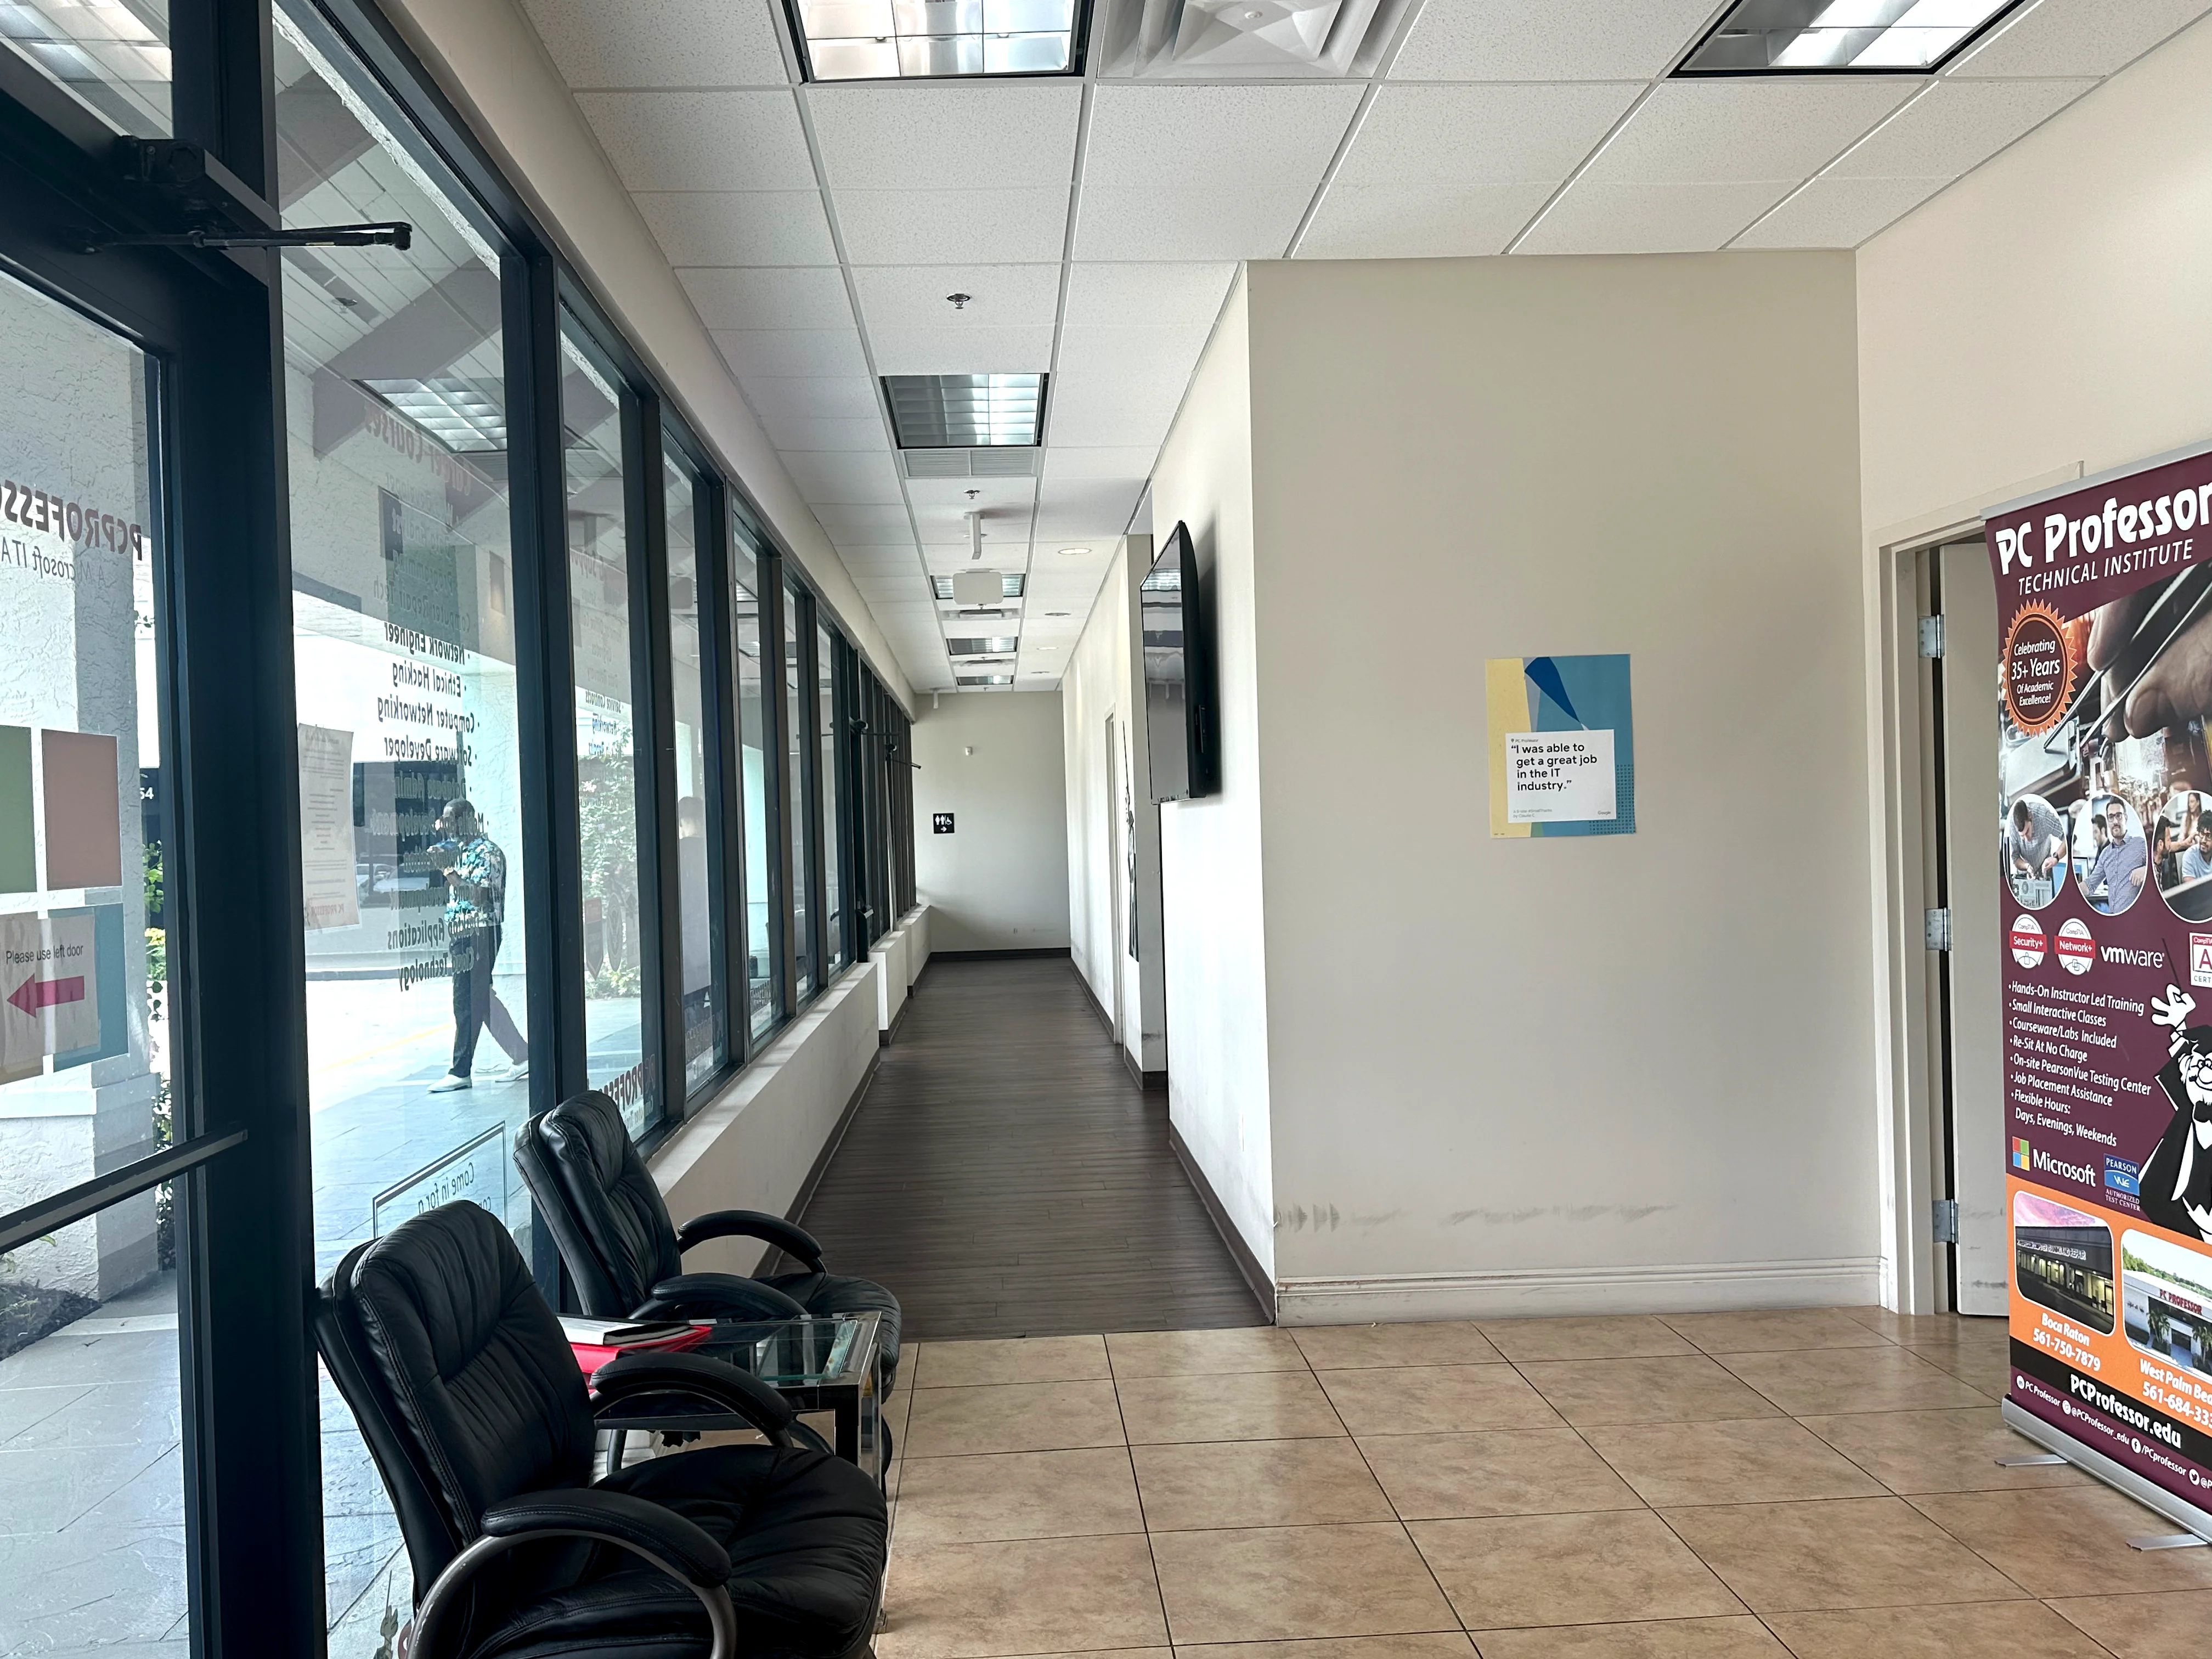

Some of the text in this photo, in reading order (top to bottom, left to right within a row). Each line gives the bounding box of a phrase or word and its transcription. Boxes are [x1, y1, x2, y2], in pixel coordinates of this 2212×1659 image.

[1995, 481, 2212, 575] PC Professor
[2018, 538, 2193, 595] TECHNICAL INSTITUTE
[2014, 639, 2056, 656] Celebrating
[2011, 658, 2060, 680] 35+ Years
[2019, 693, 2051, 706] Excellence!
[2023, 680, 2054, 693] Academic
[1516, 757, 1535, 768] get
[1547, 756, 1577, 768] great
[1579, 754, 1597, 766] job
[1522, 745, 1544, 754] was
[1547, 743, 1570, 753] able
[1573, 743, 1584, 752] to
[1517, 768, 1560, 778] in the IT
[6, 944, 83, 964] Please use left door
[2013, 936, 2044, 948] Security+
[2059, 940, 2092, 954] Network+
[2012, 981, 2144, 1017] Hands-On Instructor Led Training
[2012, 999, 2106, 1027] Small Interactive Classes
[2013, 1017, 2117, 1048] Courseware/Labs Included
[2013, 1035, 2087, 1063] Re-Sit At No Charge
[2013, 1053, 2151, 1096] On-site PearsonVue Testing Center
[2013, 1072, 2112, 1106] Job Placement Assistance
[2015, 1089, 2071, 1114] Flexible Hours:
[2015, 1107, 2117, 1147] Days, Evenings, Weekends
[2033, 1149, 2096, 1187] Microsoft
[2106, 1157, 2137, 1175] PEARSON
[2105, 1194, 2140, 1212] TEST CENTER
[2106, 1188, 2140, 1204] AUTHORIZED
[2041, 1313, 2090, 1346] Boca Raton
[2033, 1328, 2101, 1372] 561-750-7879
[2140, 1358, 2164, 1383] West
[2166, 1371, 2192, 1396] Palm
[2025, 1380, 2034, 1392] PC
[2034, 1385, 2061, 1406] Professor
[2070, 1374, 2181, 1448] PCProfessor.edu
[2071, 1406, 2130, 1446] @PCProfessor_edu
[2141, 1444, 2186, 1476] /PCprofessor
